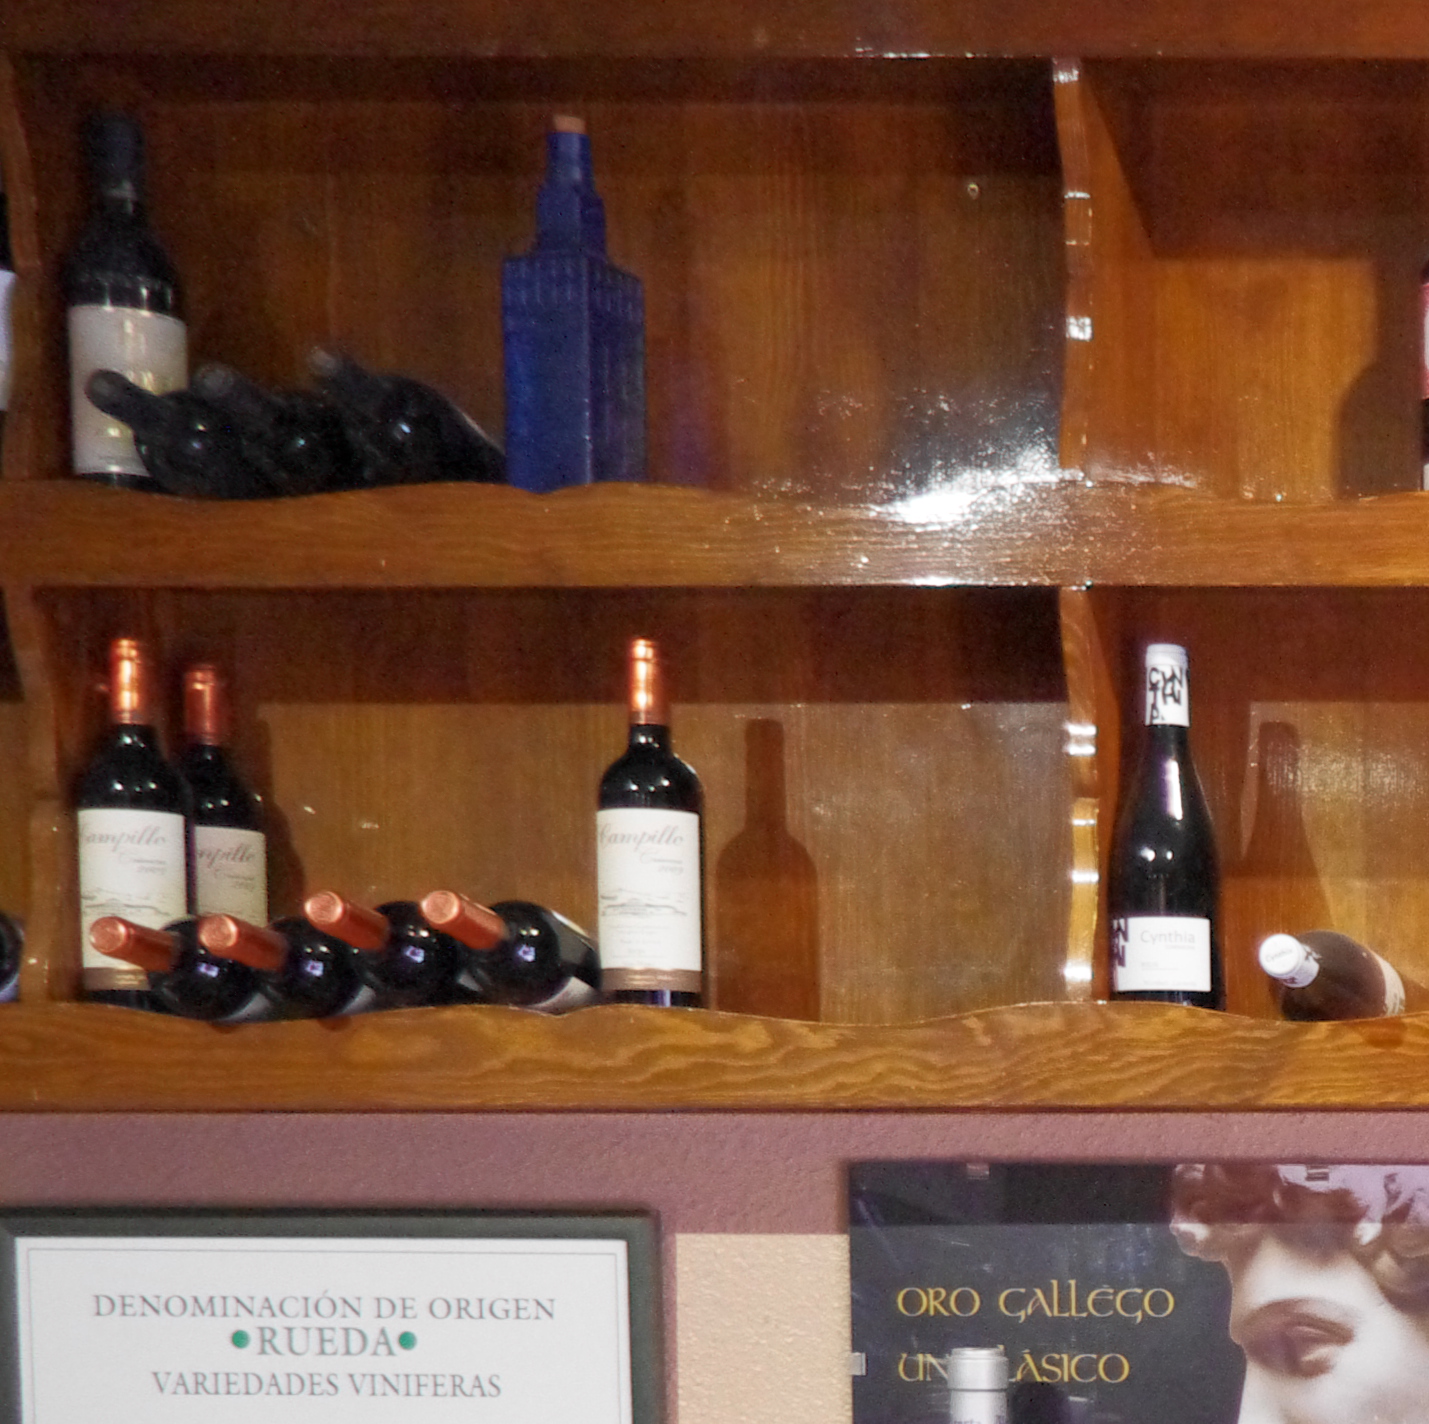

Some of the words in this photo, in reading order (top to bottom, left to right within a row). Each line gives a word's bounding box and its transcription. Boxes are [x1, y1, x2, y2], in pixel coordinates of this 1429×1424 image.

[600, 822, 685, 853] Campillo
[199, 842, 257, 869] mpillo
[1139, 929, 1197, 950] Cynthia
[93, 1289, 362, 1320] DENOMINACIÓN
[373, 1297, 418, 1320] DE
[428, 1297, 556, 1321] ORIGEN
[896, 1286, 981, 1319] ORO
[256, 1325, 398, 1357] RUEDA
[1000, 1343, 1131, 1384] LÁSICO
[152, 1370, 340, 1397] VARIEDADES
[348, 1371, 502, 1399] VINIFERAS
